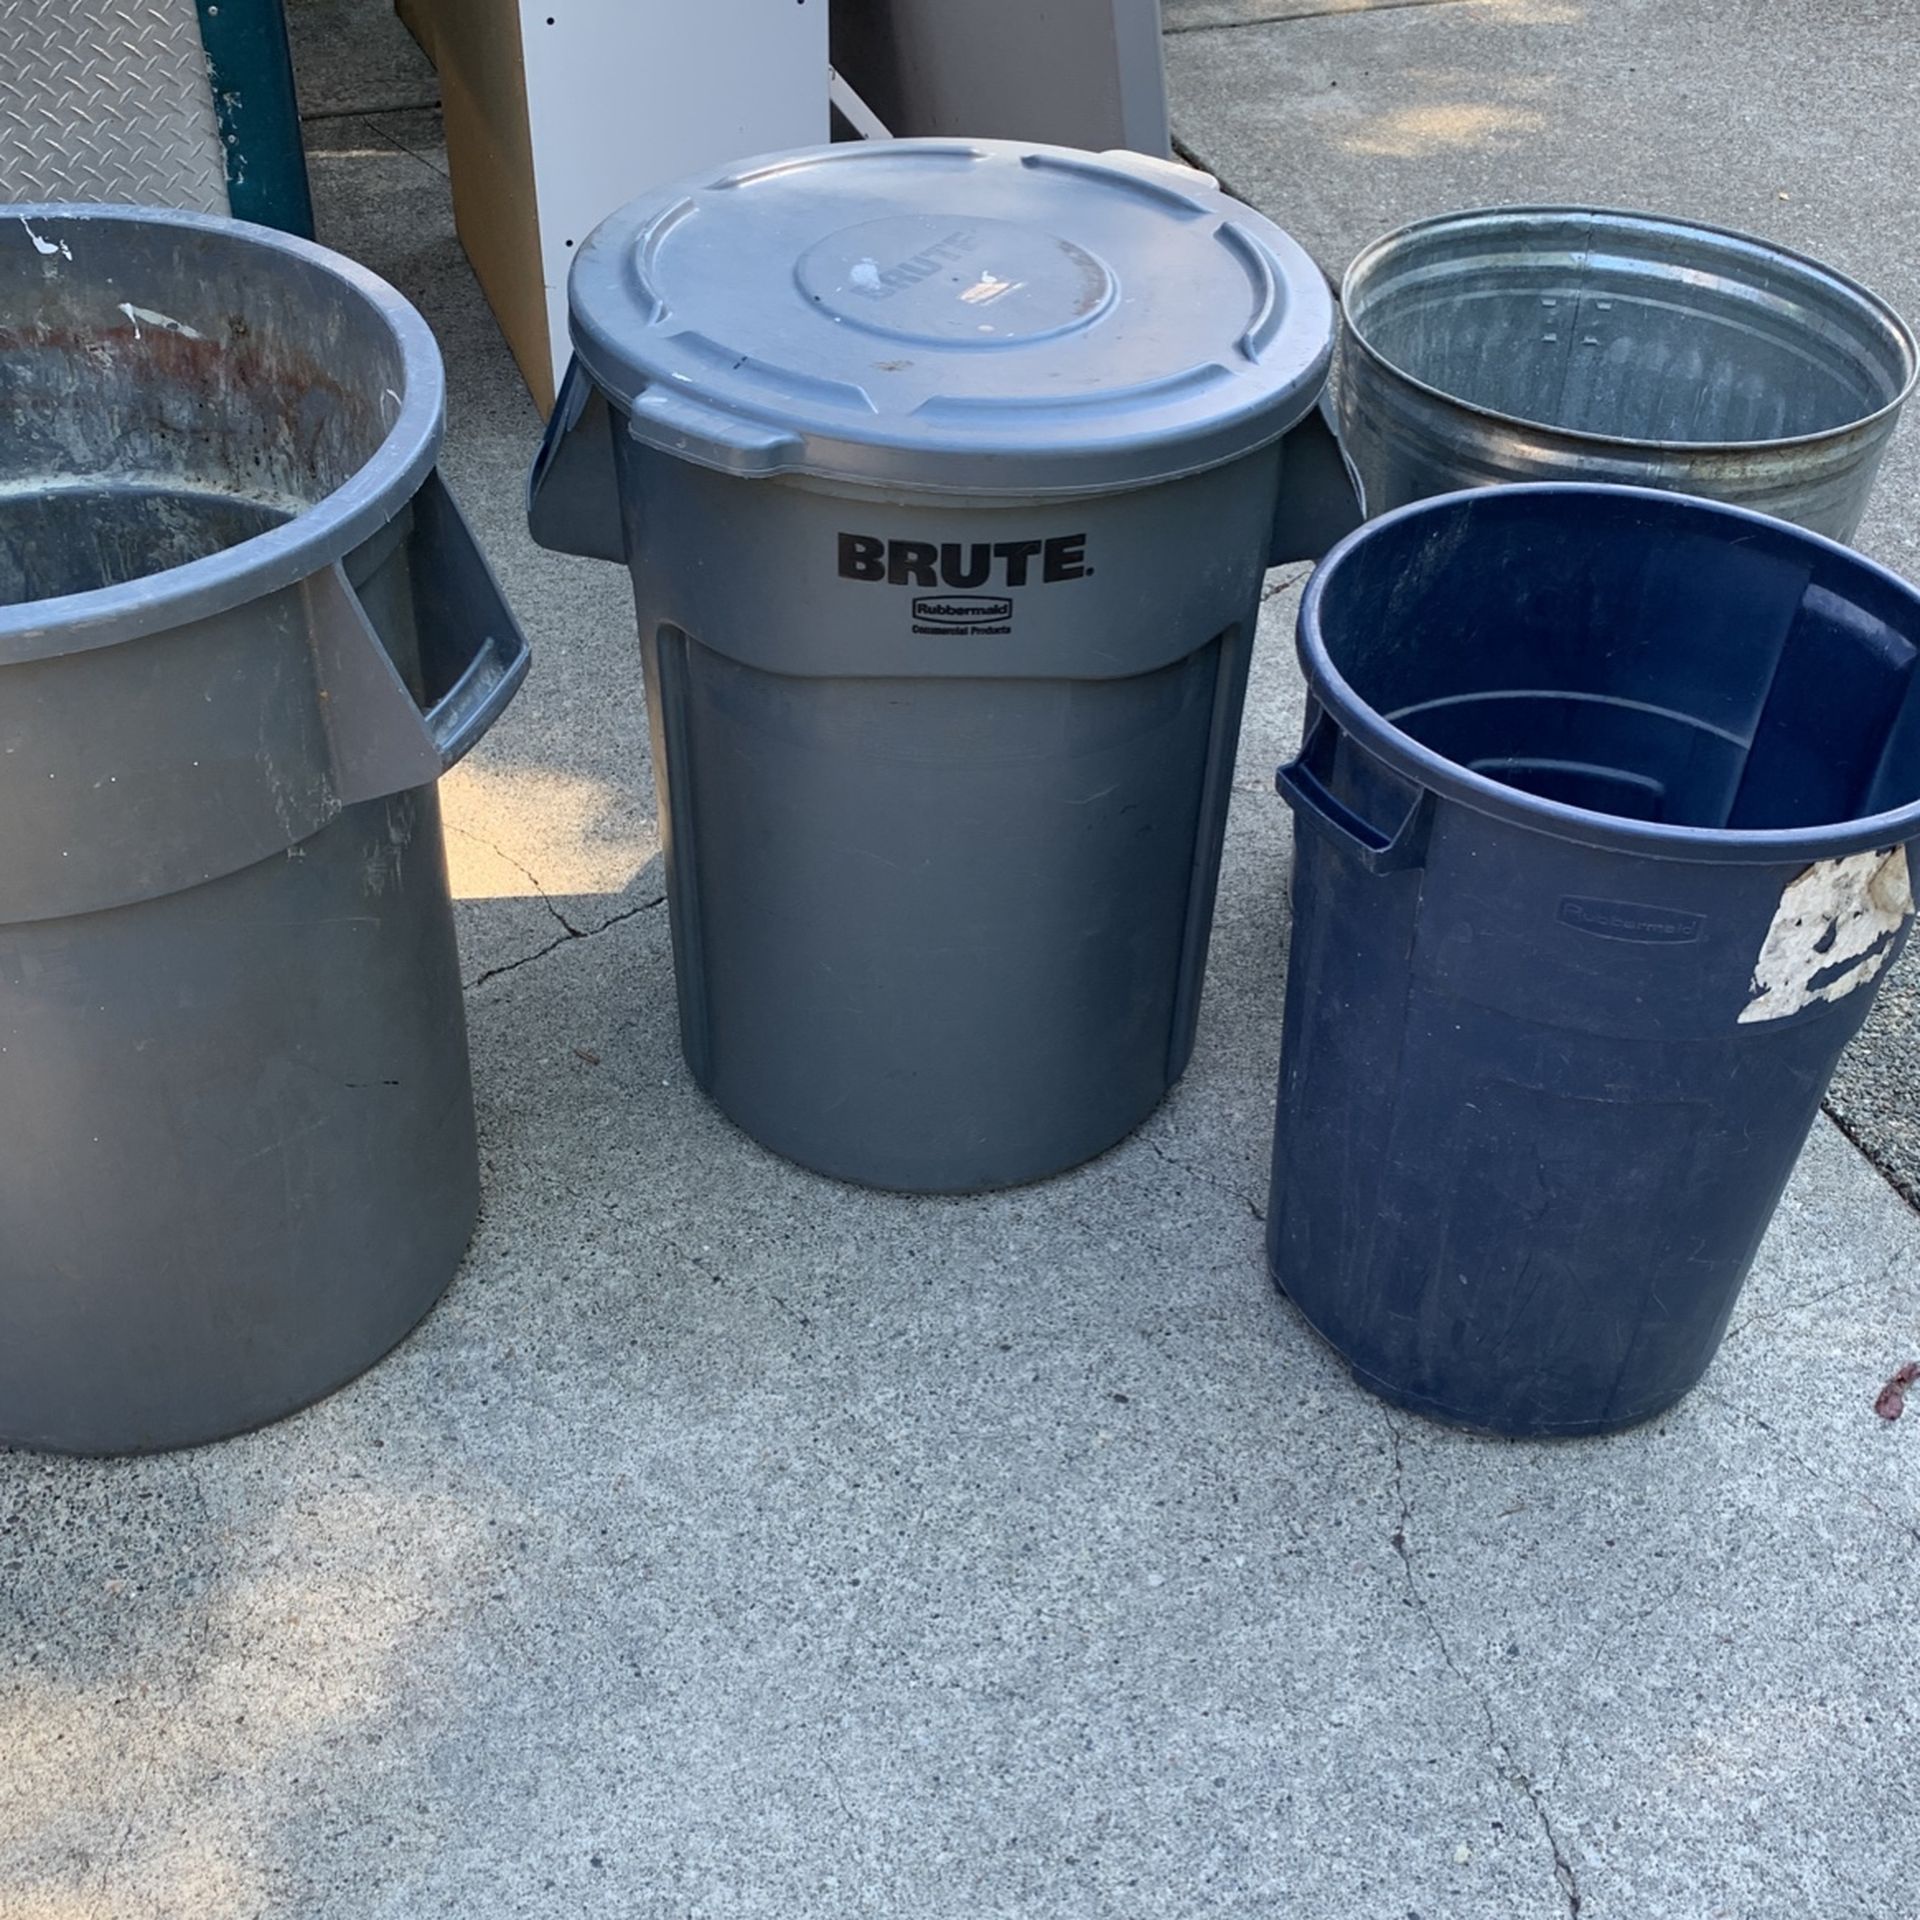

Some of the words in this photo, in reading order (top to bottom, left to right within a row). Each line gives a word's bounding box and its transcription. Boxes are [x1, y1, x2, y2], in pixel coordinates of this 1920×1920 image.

[917, 603, 1008, 616] Rubbermaid
[912, 625, 968, 635] Commercial
[971, 626, 1011, 636] Products
[1563, 902, 1697, 936] Rubbermaid
